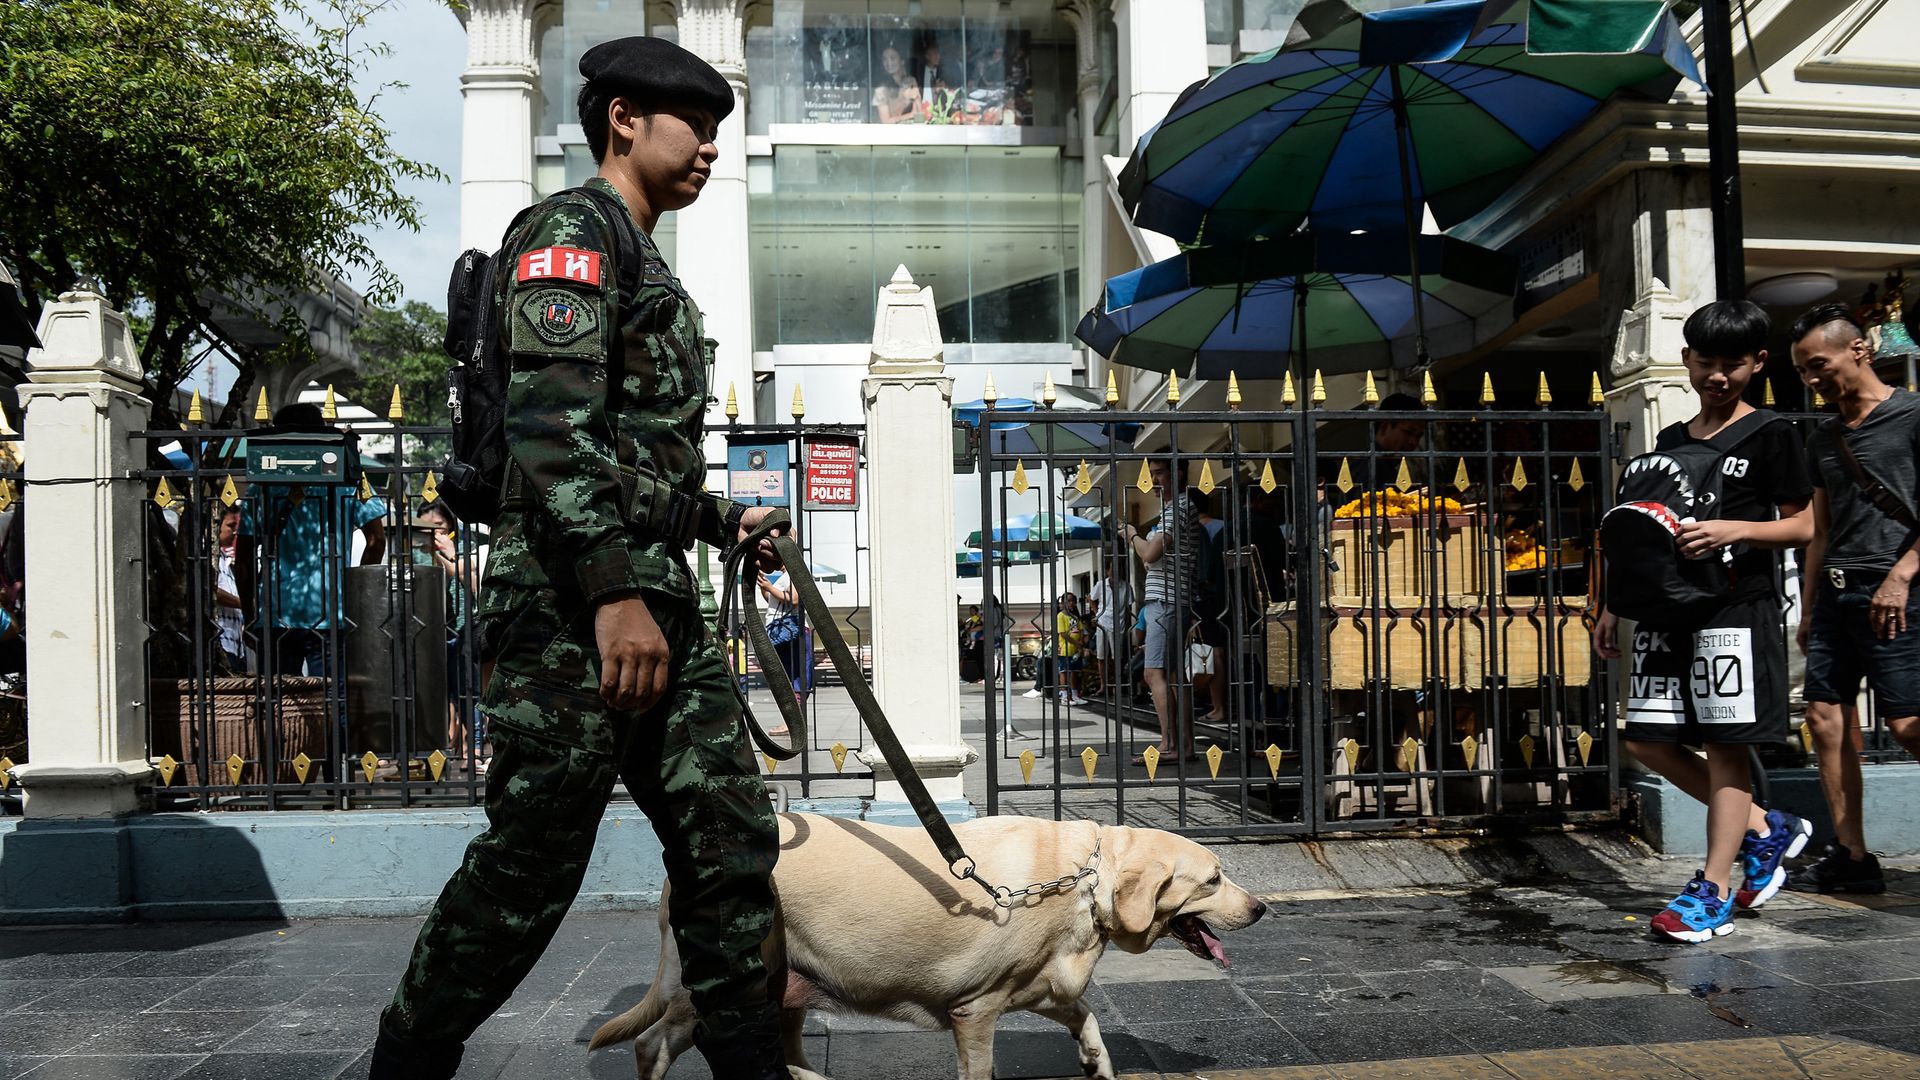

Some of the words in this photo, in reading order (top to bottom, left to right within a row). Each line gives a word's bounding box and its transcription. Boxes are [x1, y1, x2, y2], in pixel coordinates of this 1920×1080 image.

[805, 81, 859, 91] TABLES
[842, 101, 861, 109] Level
[1722, 456, 1749, 478] 03
[811, 487, 851, 500] POLICE
[1634, 631, 1671, 652] CK
[1693, 655, 1743, 699] 90
[1701, 706, 1737, 719] LONDON
